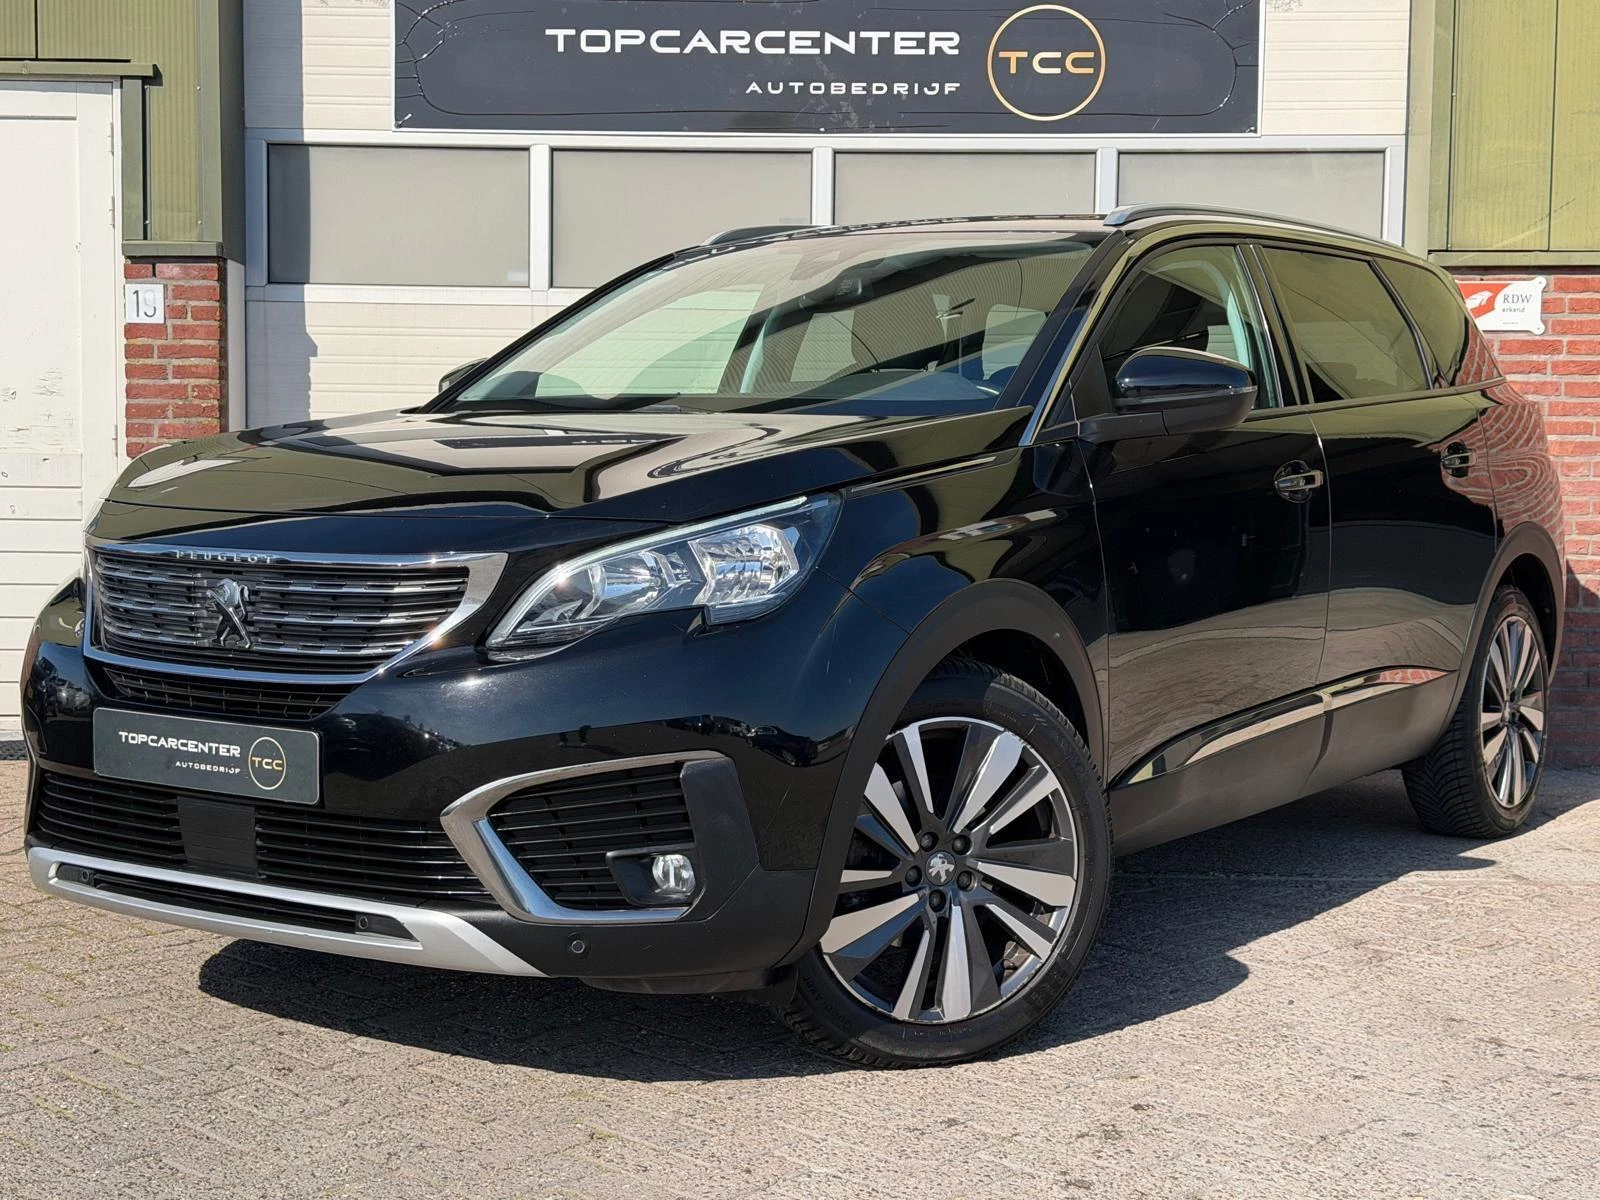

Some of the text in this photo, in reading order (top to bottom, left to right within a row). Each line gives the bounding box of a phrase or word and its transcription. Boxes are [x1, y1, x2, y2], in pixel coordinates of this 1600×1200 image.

[544, 28, 961, 56] TOPCARCENTER
[999, 50, 1095, 75] TCC
[745, 81, 961, 97] AUTOBEDRIJF
[132, 289, 157, 318] 19
[1503, 293, 1533, 304] RDW
[1501, 305, 1526, 313] erkend
[175, 550, 273, 564] PEUGEOT
[118, 731, 241, 758] TOPCARCENTER
[175, 760, 241, 775] AUTOBEDRIJF
[252, 756, 282, 771] TCC
